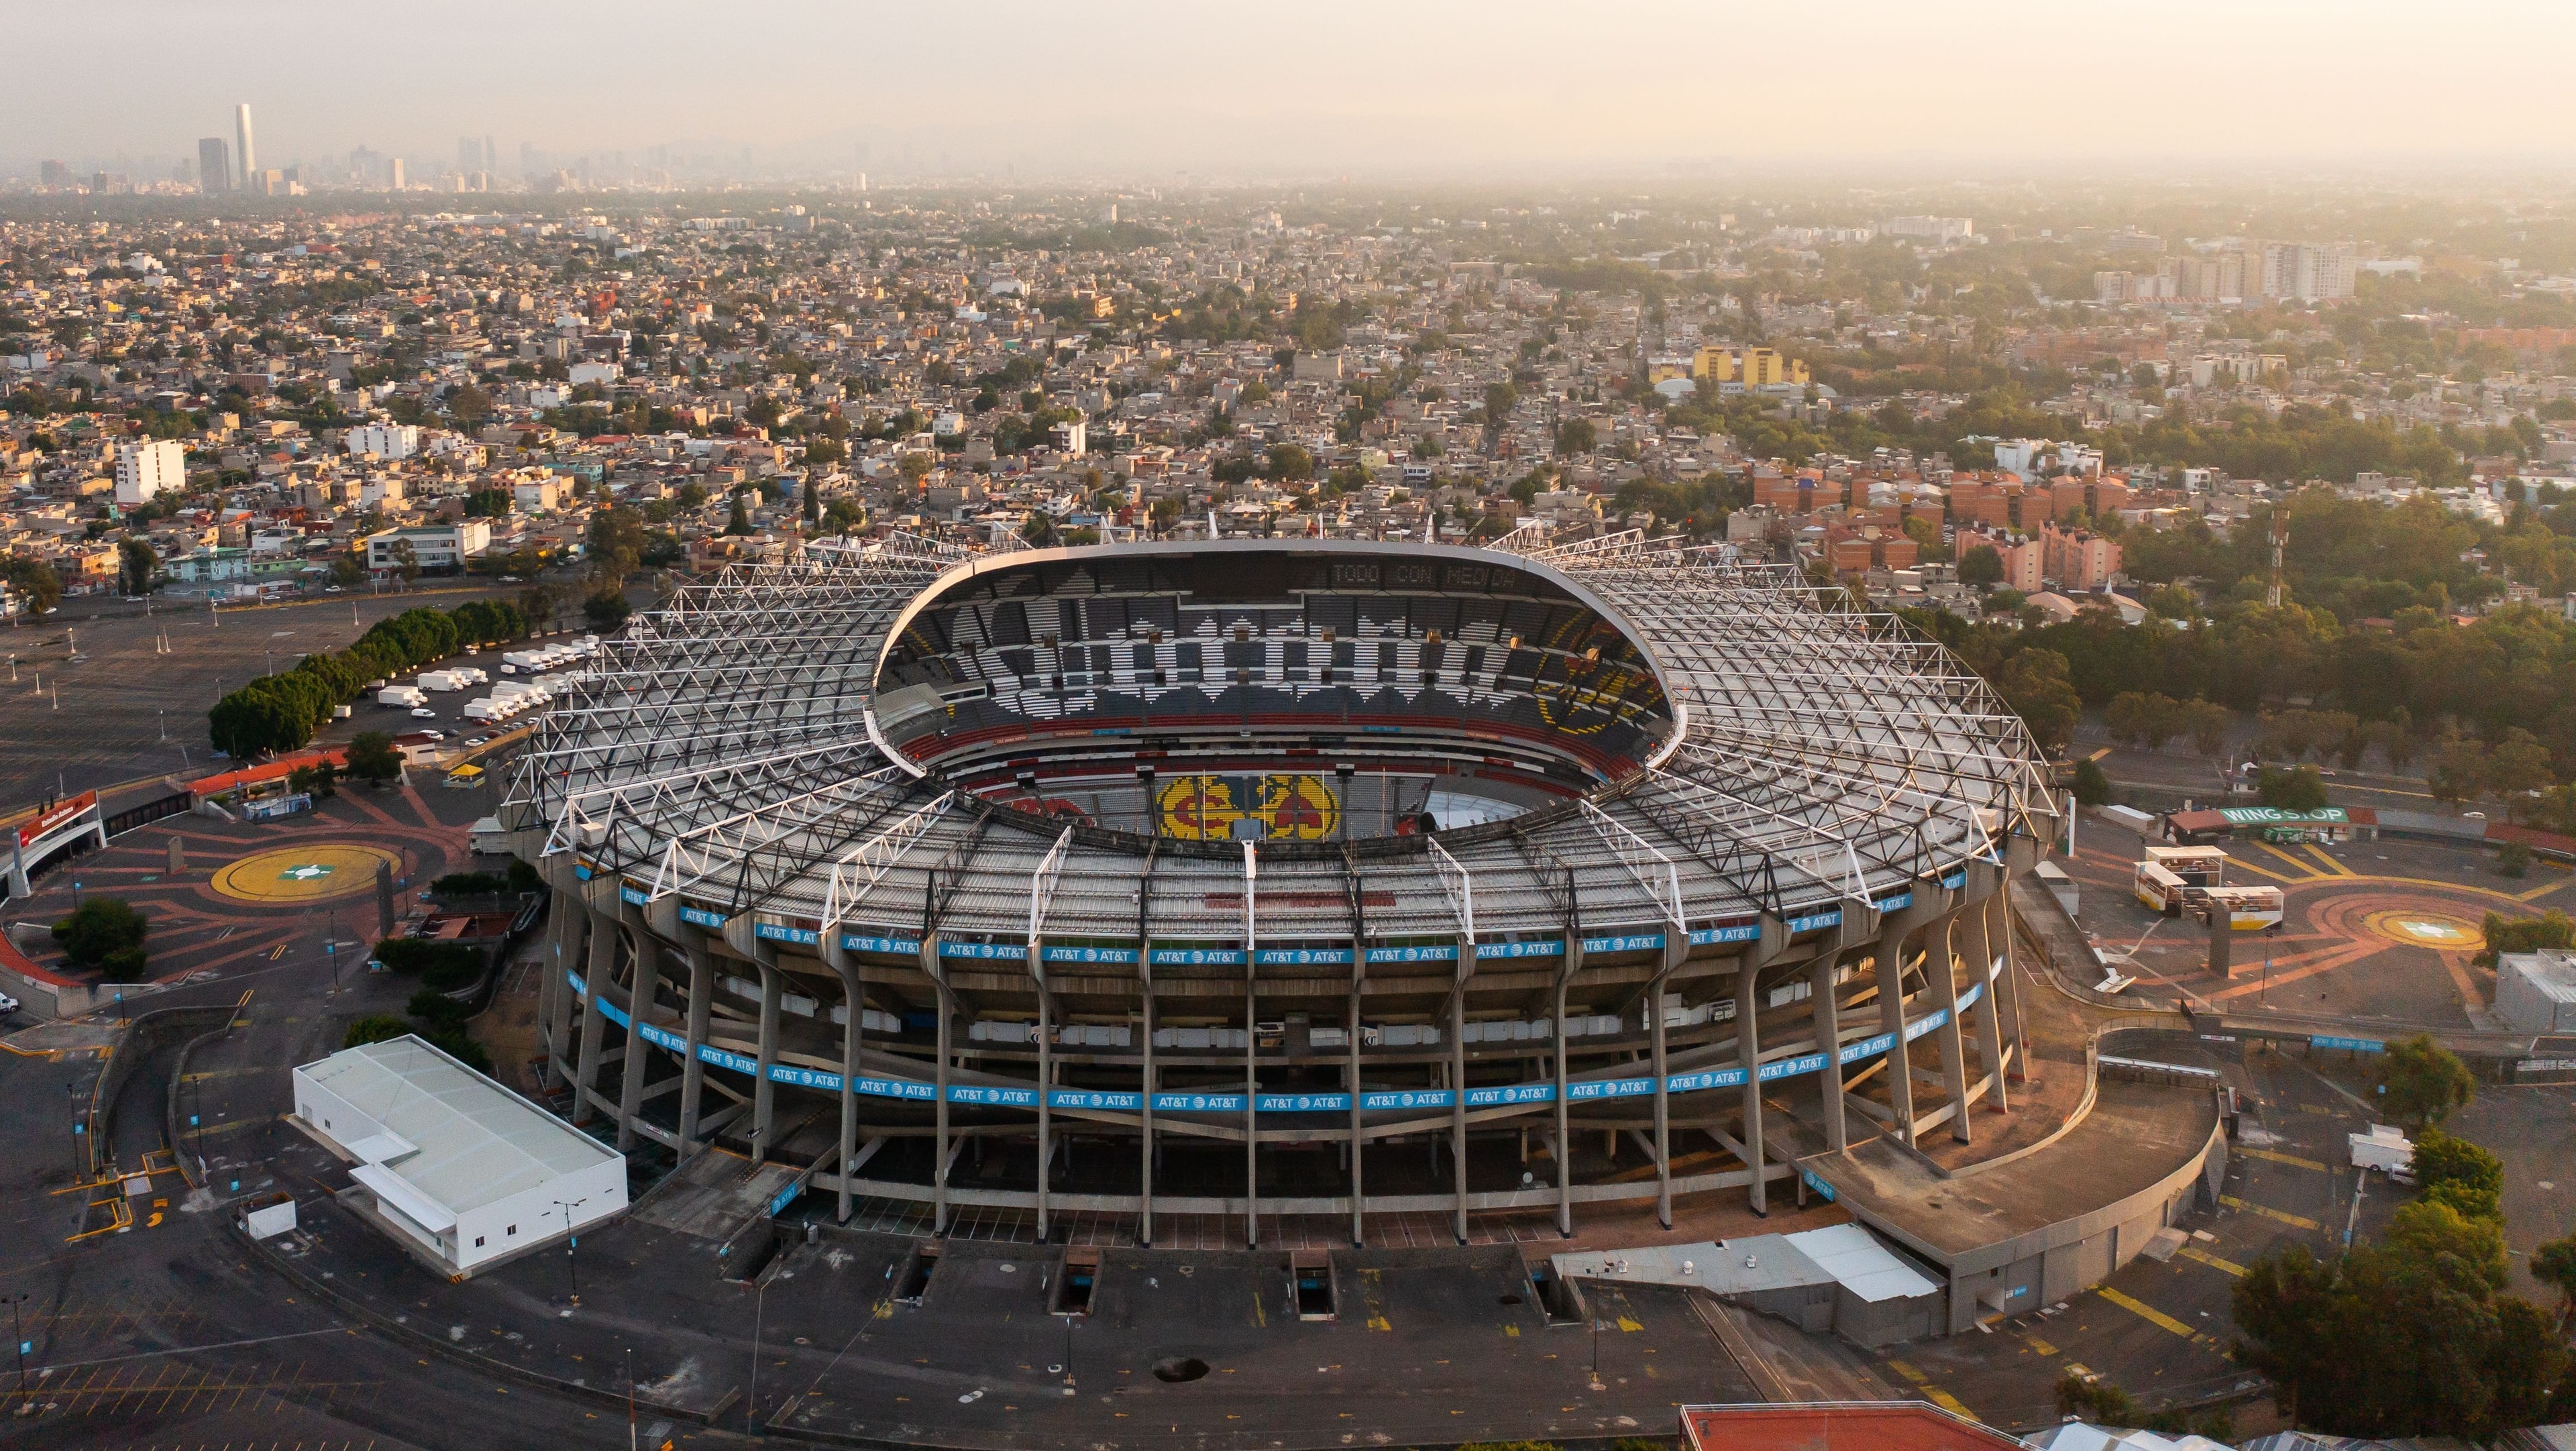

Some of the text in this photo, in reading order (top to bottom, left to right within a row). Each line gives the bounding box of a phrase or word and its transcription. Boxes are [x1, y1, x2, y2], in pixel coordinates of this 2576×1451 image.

[1946, 875, 1962, 889] AT&T
[625, 890, 643, 904] AT&T
[1886, 897, 1905, 911] AT&T
[686, 910, 706, 922] AT&T
[1813, 914, 1837, 928] AT&T
[762, 926, 787, 939] AT&T
[1689, 928, 1752, 943] T&T AT&T
[847, 938, 875, 949] AT&T
[1628, 937, 1657, 949] AT&T
[948, 945, 1026, 958] AT&T AT&T
[1050, 949, 1129, 961] AT&T AT&T
[1157, 952, 1237, 962] AT&T AT&T
[1263, 952, 1343, 962] AT&T AT&T
[1371, 949, 1450, 961] AT&T AT&T
[1477, 944, 1556, 957] AT&T AT&T
[1929, 1014, 1945, 1026] AT&T
[642, 1027, 659, 1040] AT&T
[1839, 1036, 1891, 1061] AT&T AT&T
[702, 1049, 756, 1072] AT&T AT&T
[1759, 1057, 1823, 1078] AT&T AT&T
[773, 1069, 840, 1087] AT&T AT&T
[1670, 1072, 1742, 1089] AT&T AT&T
[860, 1081, 933, 1097] AT&T AT&T
[1572, 1081, 1648, 1095] AT&T AT&T
[955, 1089, 1031, 1102] AT&T AT&T
[1057, 1095, 1135, 1106] AT&T AT&T
[1367, 1093, 1446, 1106] AT&T AT&T
[1470, 1088, 1548, 1102] AT&T AT&T
[1159, 1097, 1238, 1108] AT&T AT&T
[1264, 1097, 1342, 1108] AT&T AT&T
[1815, 1180, 1834, 1196] AT&T
[781, 1187, 796, 1205] AT&T
